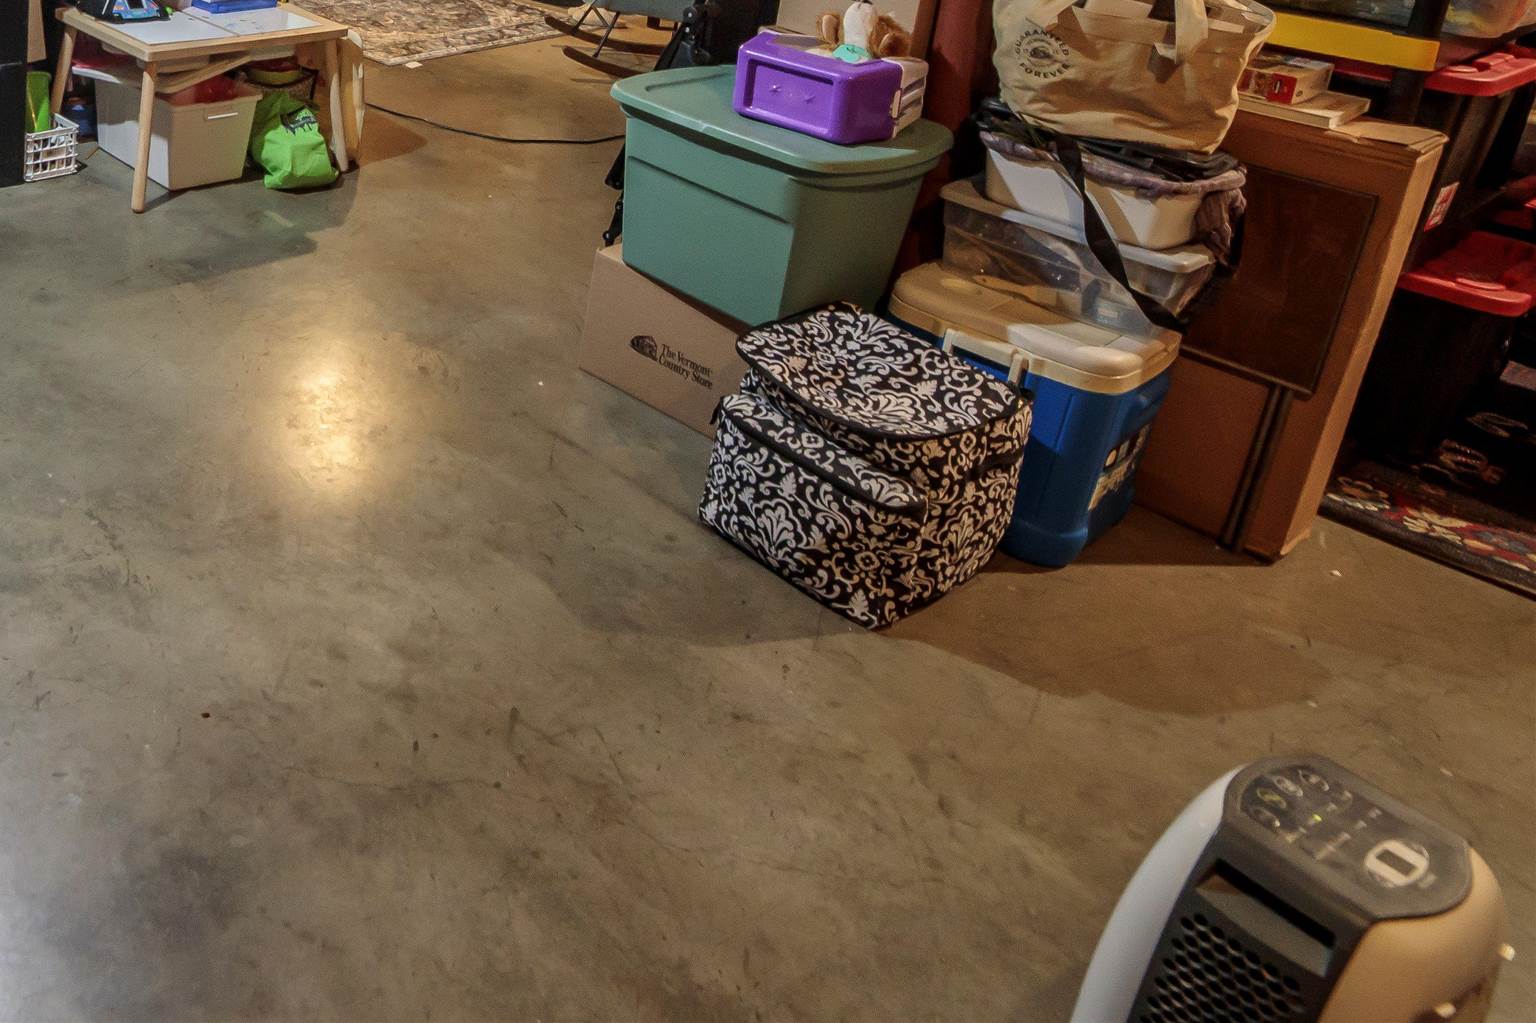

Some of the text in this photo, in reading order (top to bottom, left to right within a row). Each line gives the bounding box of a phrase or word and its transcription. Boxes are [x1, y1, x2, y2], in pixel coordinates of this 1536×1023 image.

[1015, 29, 1069, 55] GUARANTEED
[1019, 63, 1070, 78] FOREVER
[659, 353, 713, 390] Country Store
[662, 344, 710, 378] The Vermont
